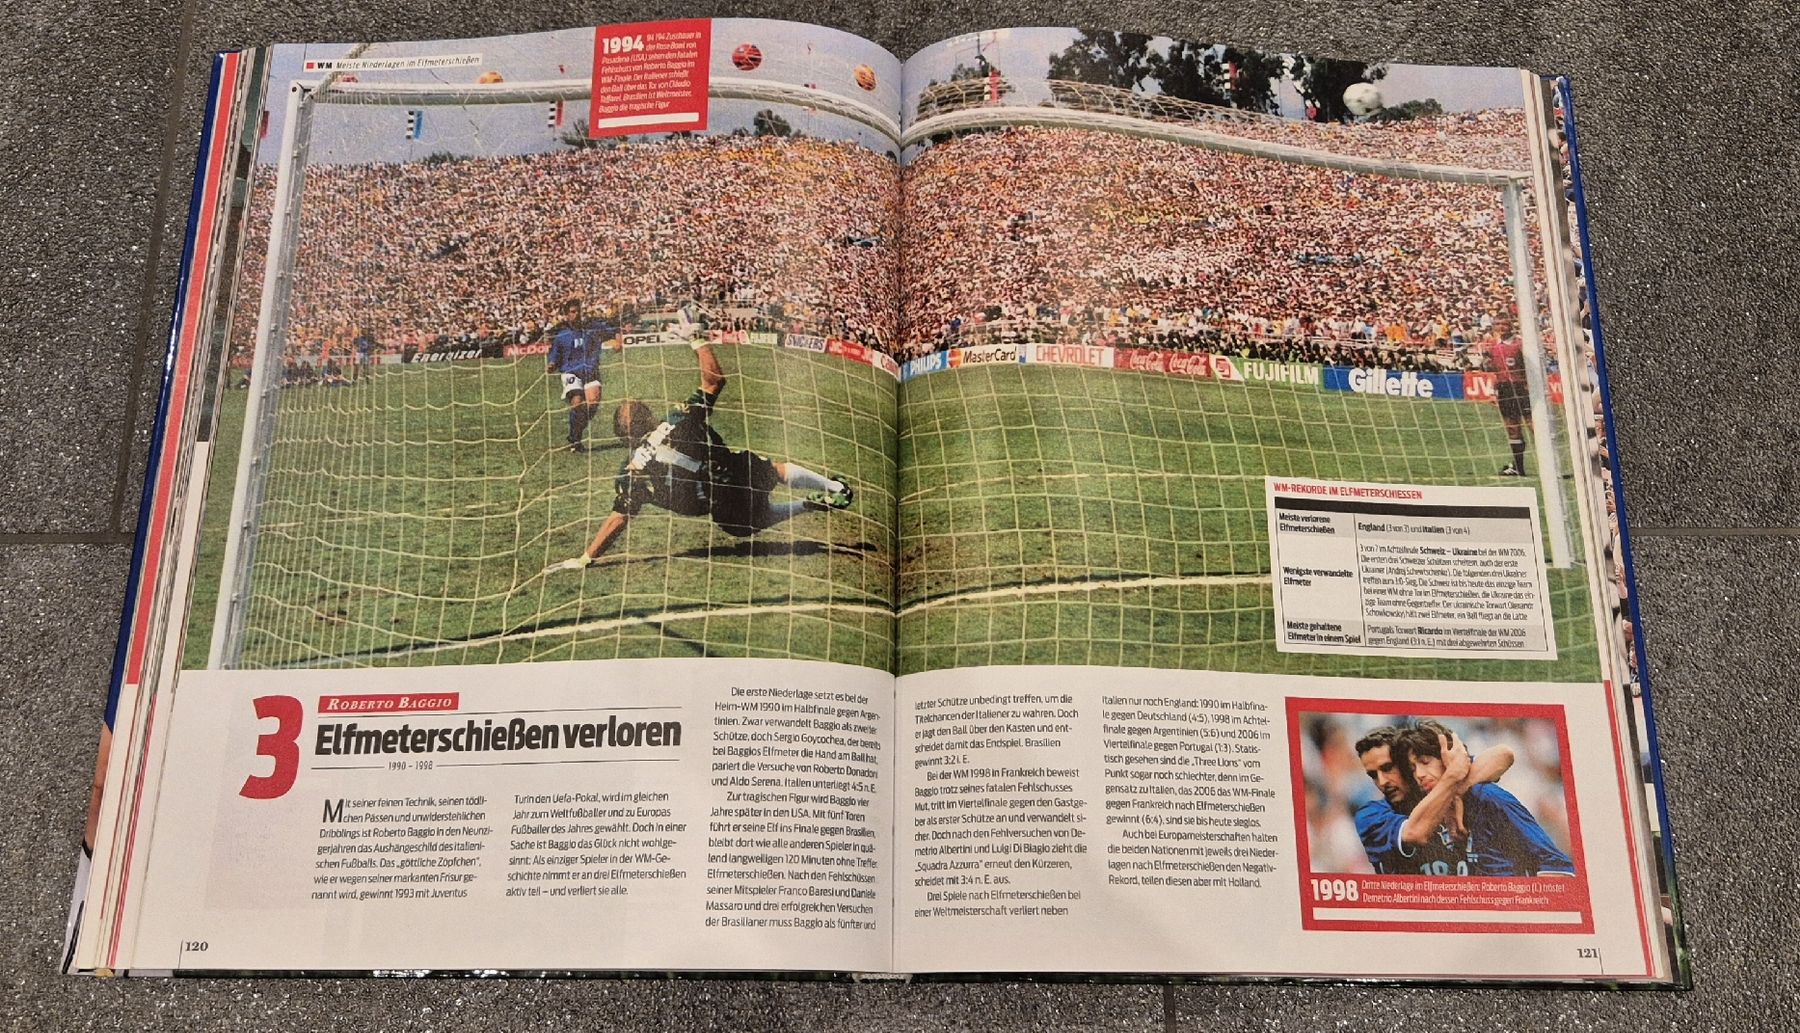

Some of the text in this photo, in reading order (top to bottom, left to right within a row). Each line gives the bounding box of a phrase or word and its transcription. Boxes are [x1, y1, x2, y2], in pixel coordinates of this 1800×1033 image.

[603, 35, 644, 54] 1994
[362, 60, 405, 69] Niederlagen
[407, 59, 415, 67] im
[417, 56, 480, 67] Elfmeterschießen
[624, 335, 665, 345] OPEL
[786, 334, 825, 350] SNICKERS
[410, 349, 482, 363] Energizer
[963, 347, 1017, 364] MasterCard
[1036, 345, 1105, 365] CHEVROLET
[910, 352, 942, 375] PHILIPS
[1243, 362, 1319, 385] FUJIFILM
[1348, 367, 1433, 398] Gillette
[1274, 483, 1423, 499] WM-REKORDE IM ELFMETERSCHIESSEN
[1279, 513, 1330, 523] Meiste verlorene
[1280, 523, 1335, 534] Elfmeterschießen
[1283, 567, 1312, 576] Wenigste
[1284, 577, 1311, 586] Elfmeter
[1287, 621, 1341, 632] Meiste gehaltene
[1288, 632, 1315, 641] Elfmeter
[1324, 634, 1344, 642] einem
[1345, 635, 1361, 643] Spiel
[731, 687, 868, 704] Die erste Niederlage setzt es bei der
[326, 695, 452, 711] ROBERTO BAGGIO
[1102, 696, 1268, 711] Italien nur noch England: 1990 im Halbfina-
[715, 702, 880, 720] Heim-WM 1990 im Halbfinale gegen Argen-
[314, 715, 682, 756] Elfmeterschießen verloren
[239, 695, 304, 800] 3
[388, 761, 406, 771] 1990
[415, 760, 433, 770] 1998
[927, 767, 1079, 781] Bei der WM 1998 in Frankreich beweist
[915, 782, 1072, 797] Baggio trotz seines fatalen Fehlschusses
[353, 800, 377, 808] seiner
[378, 798, 403, 807] feinen
[405, 797, 437, 807] Technik,
[439, 798, 464, 806] seinen
[343, 811, 485, 823] chen Pässen und unwiderstehlichen
[513, 807, 671, 819] Jahr zum Weltfußballer und zu Europas
[320, 826, 493, 839] Dribblings ist Roberto Baggio in den Neunzi-
[511, 822, 686, 834] Fußballer des Jahres gewählt. Doch in einer
[1123, 830, 1277, 842] Auch bei Europameisterschaften halten
[1108, 844, 1278, 857] die beiden Nationen mit jeweils drei Nieder-
[508, 869, 686, 881] schichte nimmt er an drei Elfmeterschießen
[707, 869, 875, 883] Elfmeterschießen. Nach den Fehlschüssen
[1311, 879, 1358, 901] 1998
[915, 905, 1068, 917] einer Weltmeisterschaft verliert neben
[185, 941, 208, 952] 120
[1577, 948, 1598, 959] 121
